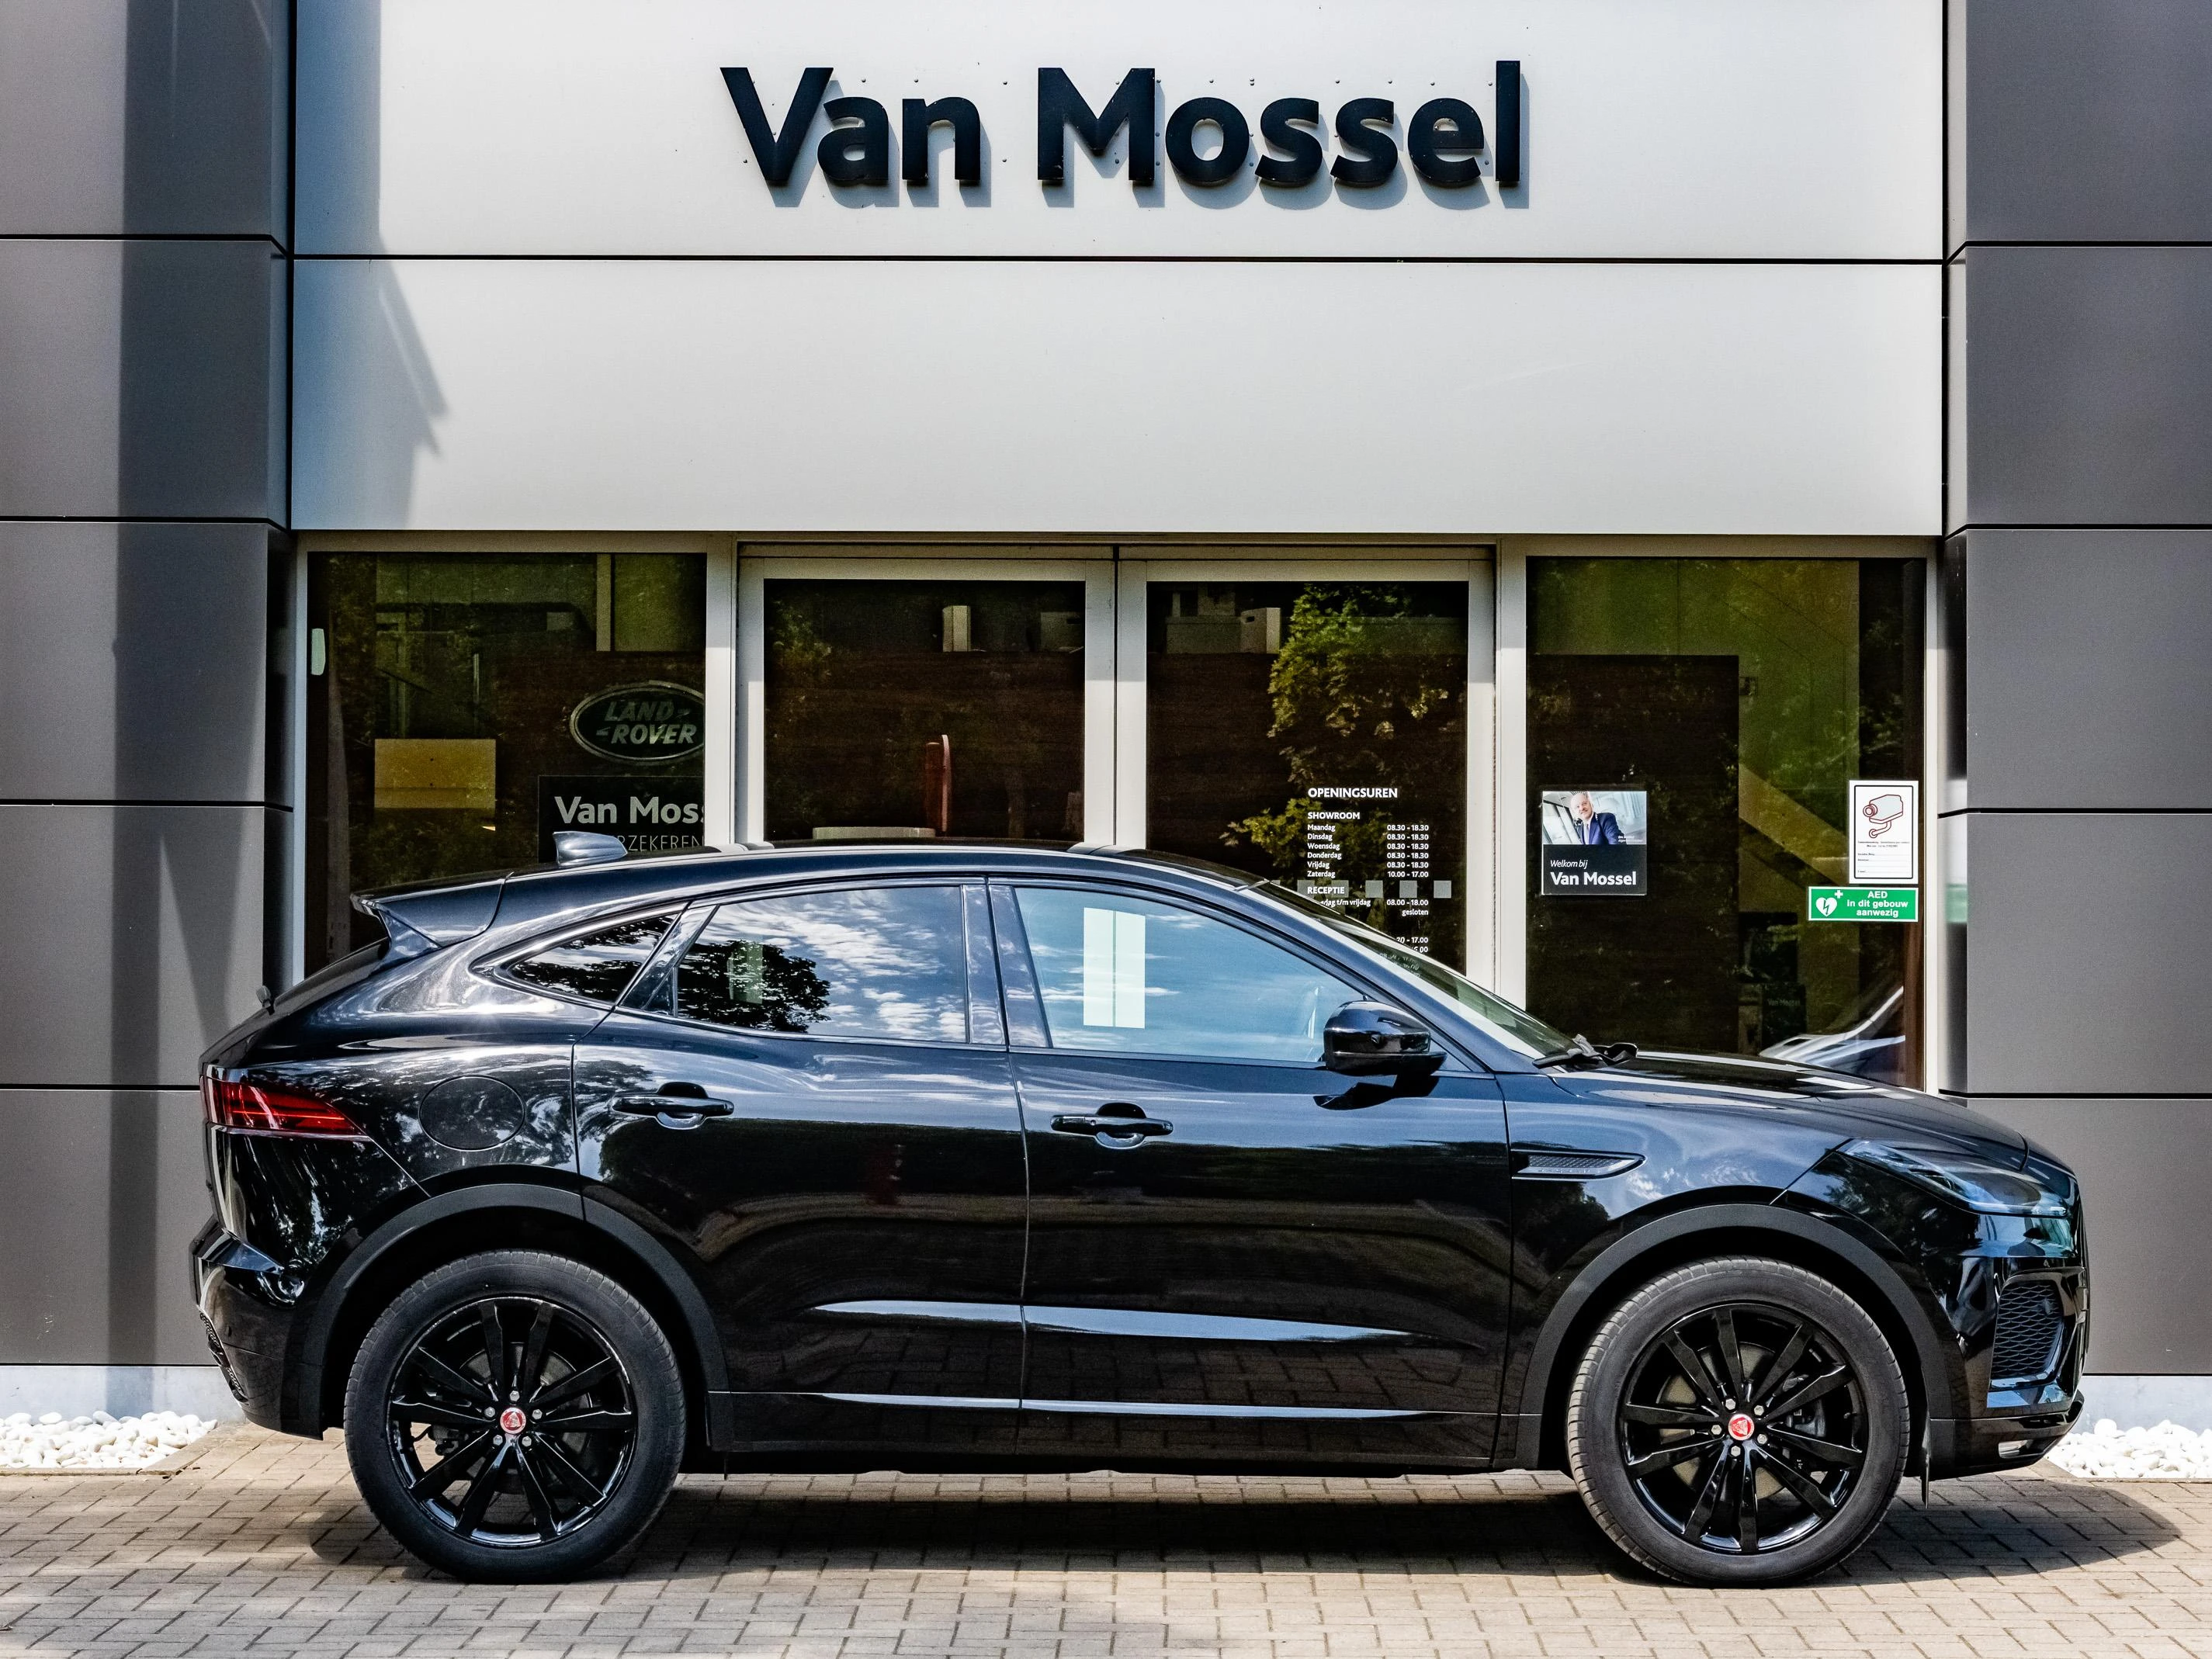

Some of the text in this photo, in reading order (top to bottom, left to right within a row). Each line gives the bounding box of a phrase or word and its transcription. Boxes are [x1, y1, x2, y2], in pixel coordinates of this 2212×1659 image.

[720, 60, 1522, 187] Van Mossel
[604, 701, 674, 722] LAND
[610, 724, 697, 744] ROVER
[1307, 788, 1398, 798] OPENINGSUREN
[553, 796, 706, 824] Van Mos
[1307, 824, 1336, 833] Maandag
[1307, 833, 1333, 842] Dinsdag
[1307, 843, 1340, 851] Woensdag
[1307, 852, 1342, 861] Donderdag
[1307, 861, 1330, 870] Vrijdag
[1550, 859, 1589, 869] Welkom bij
[1307, 871, 1336, 879] Zaterdag
[1550, 871, 1637, 885] Van Mossel
[1307, 886, 1345, 895] RECEPTIE
[1873, 900, 1909, 909] gebouw
[1402, 909, 1429, 917] gesloten
[1856, 909, 1898, 918] aanwezig
